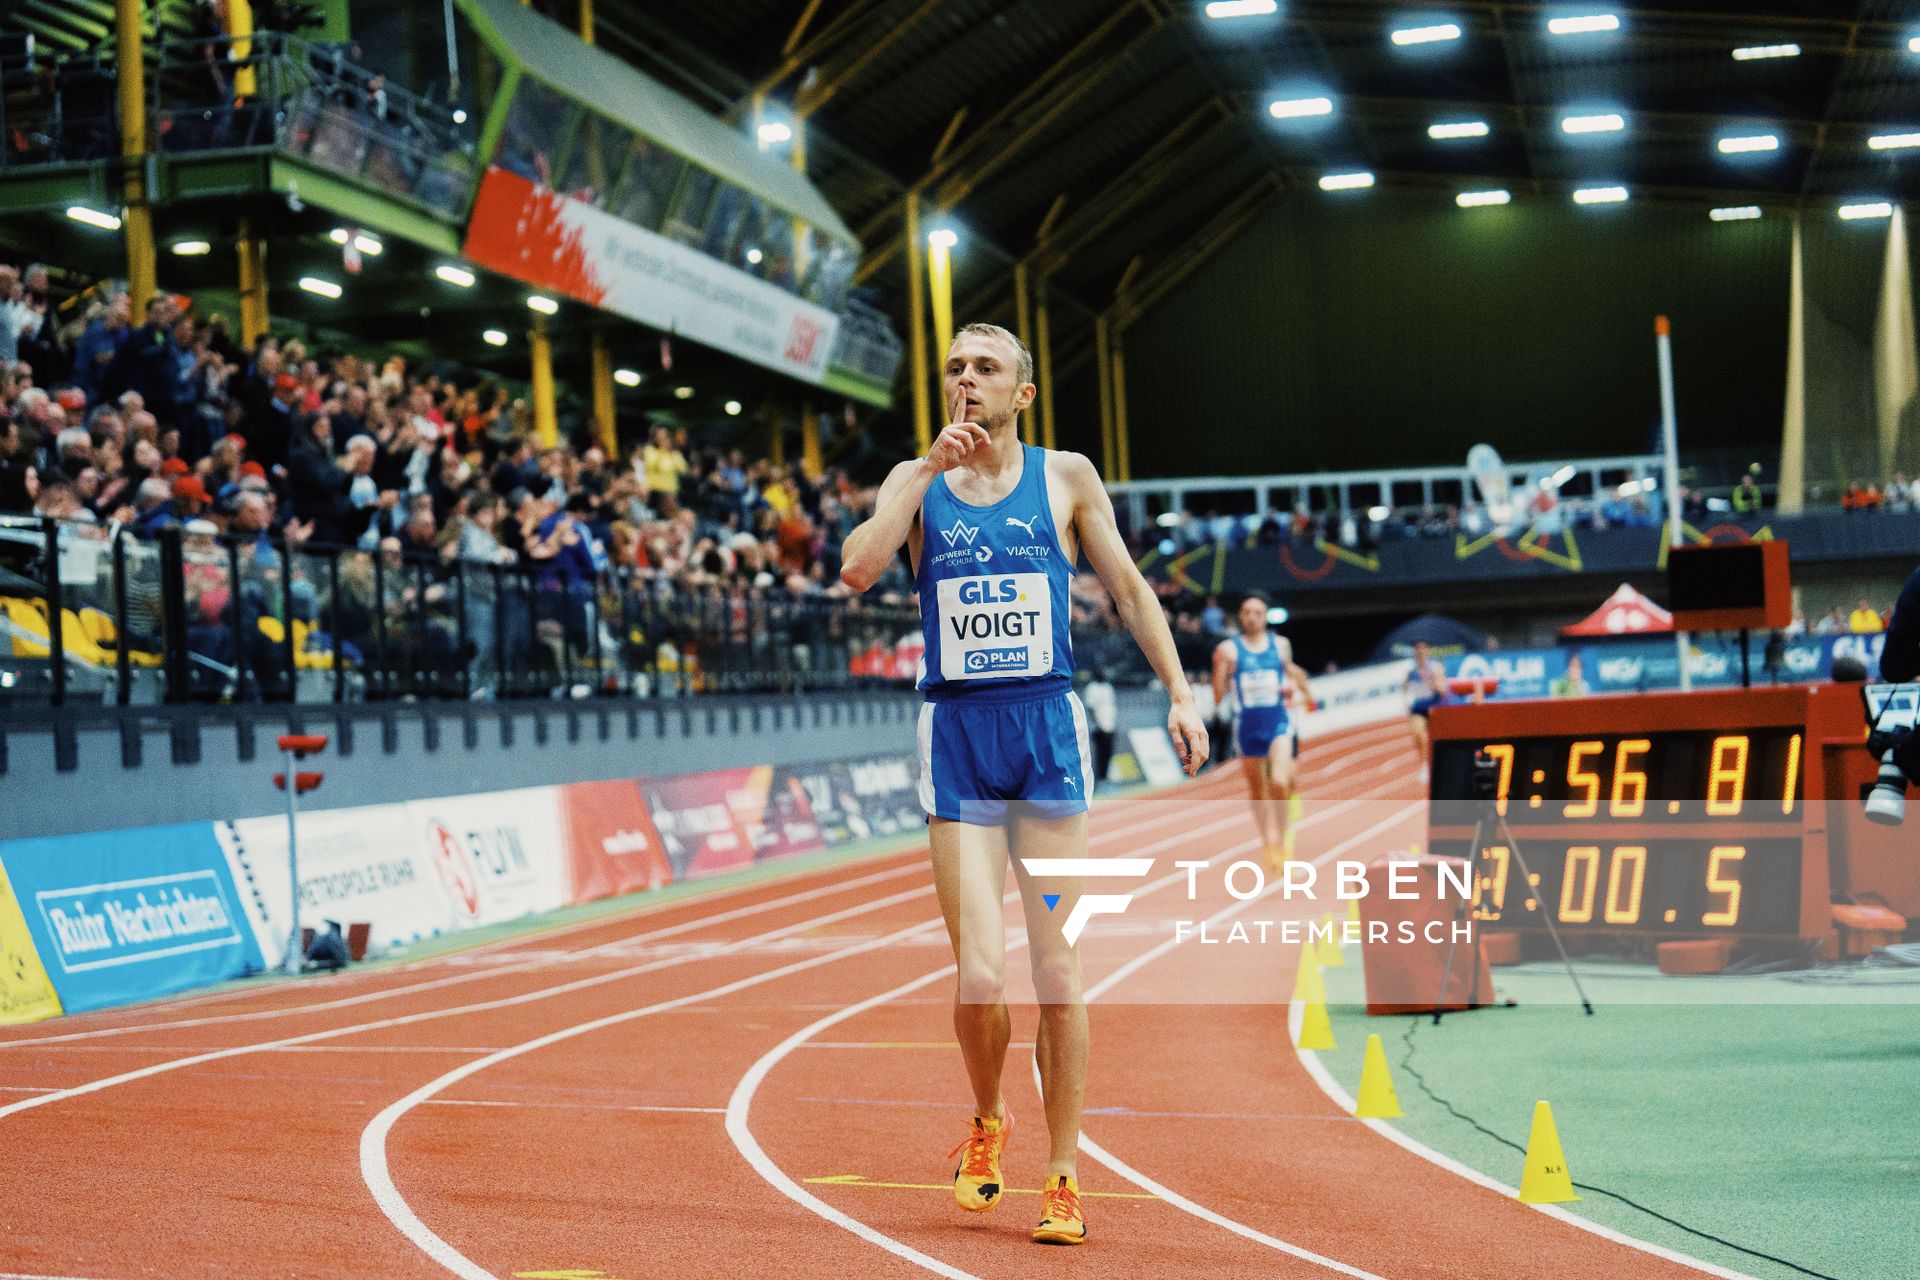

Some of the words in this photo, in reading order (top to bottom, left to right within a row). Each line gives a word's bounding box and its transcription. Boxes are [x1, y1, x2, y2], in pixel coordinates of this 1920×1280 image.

[1005, 546, 1050, 557] VIACTIV
[950, 611, 1041, 641] VOIGT
[990, 651, 1027, 663] PLAN
[49, 900, 113, 955] Ruhr
[103, 886, 229, 946] Nachrichten
